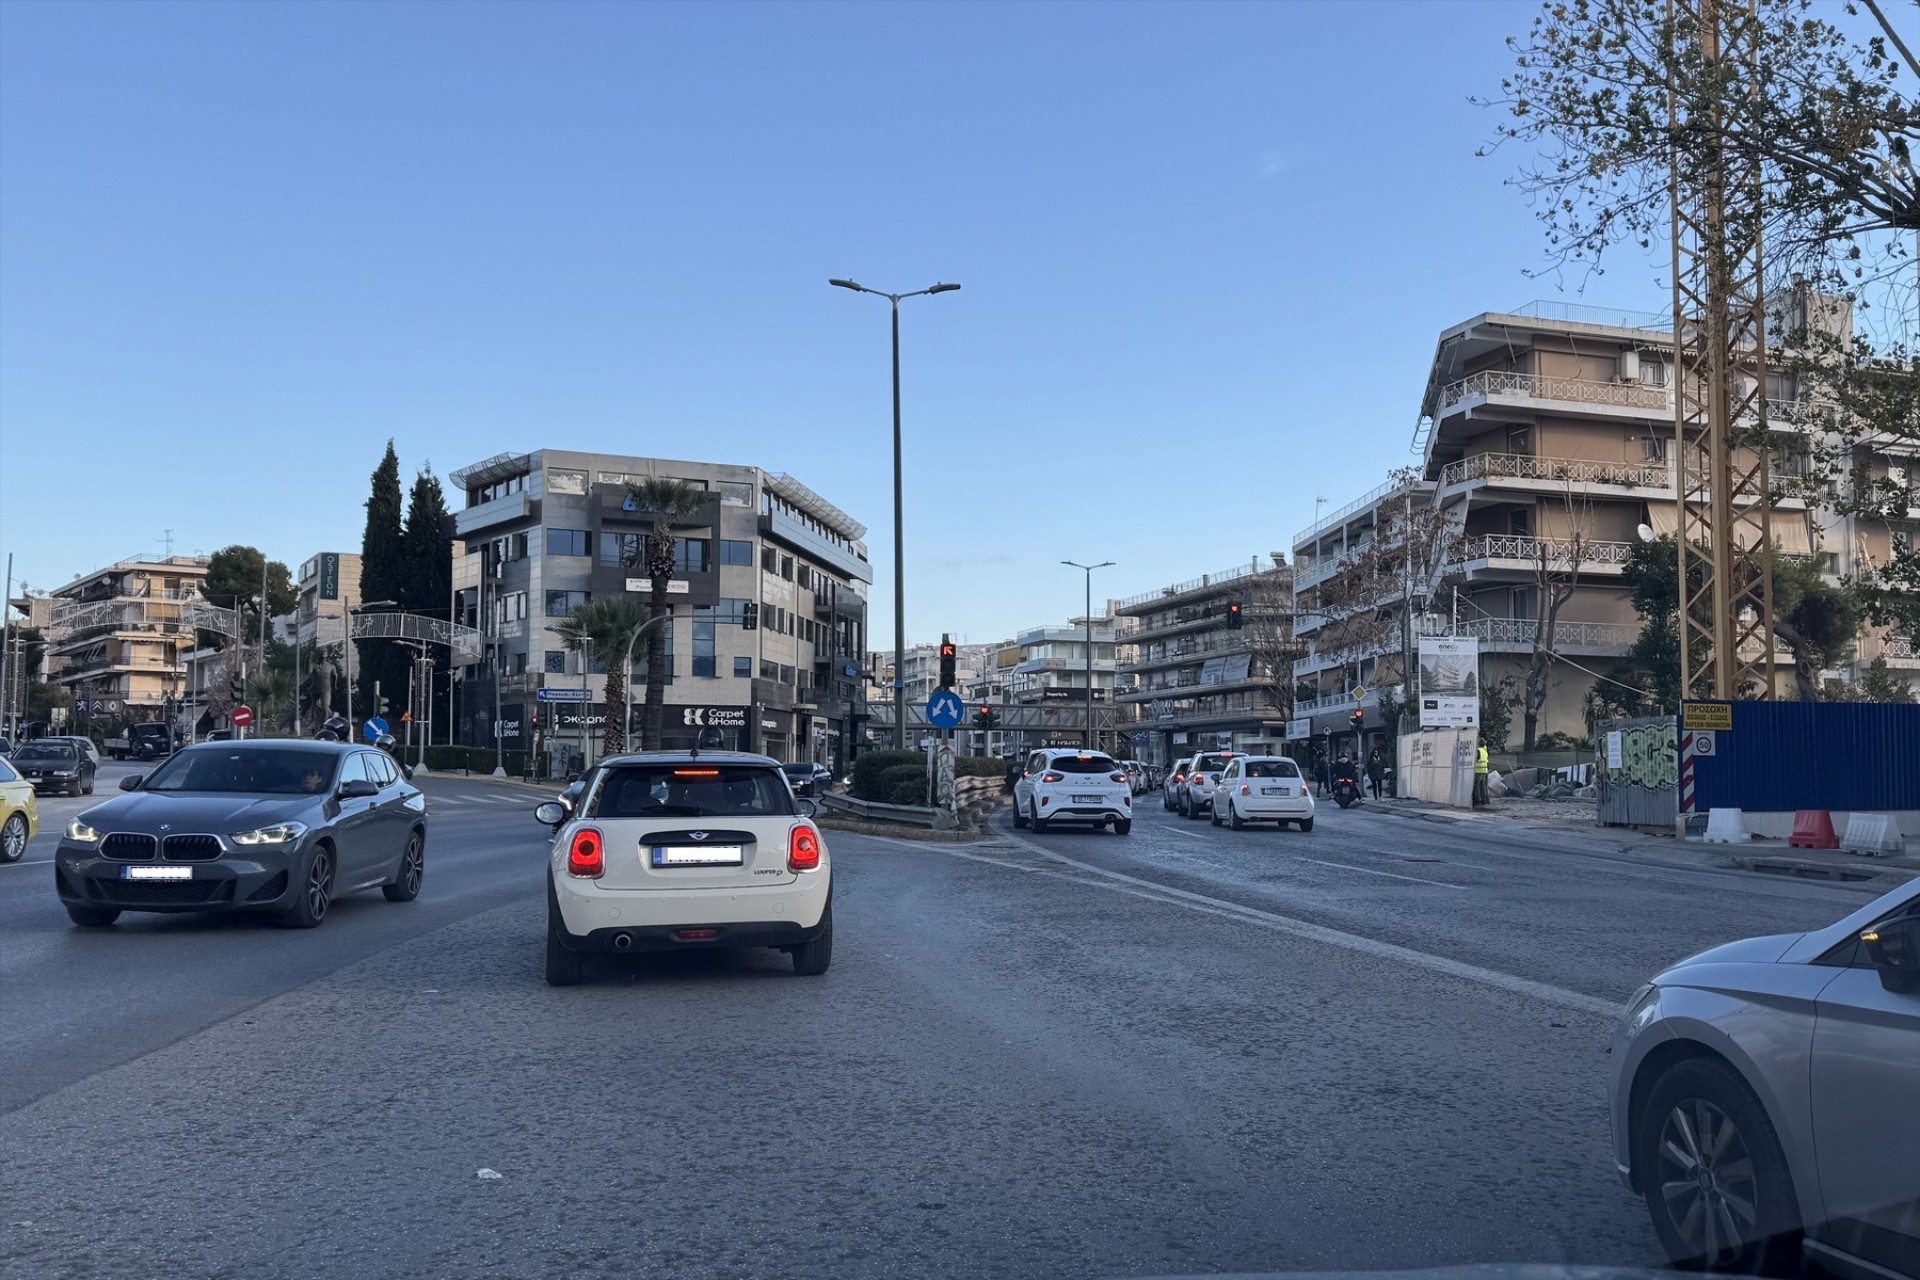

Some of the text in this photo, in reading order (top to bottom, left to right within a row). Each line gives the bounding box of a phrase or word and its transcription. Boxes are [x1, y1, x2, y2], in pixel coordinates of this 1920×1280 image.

[326, 555, 335, 597] OSTEON
[708, 708, 744, 718] Carpet
[1687, 705, 1728, 714] ΠΡΟΣΟΧΗ
[1700, 741, 1709, 749] 50
